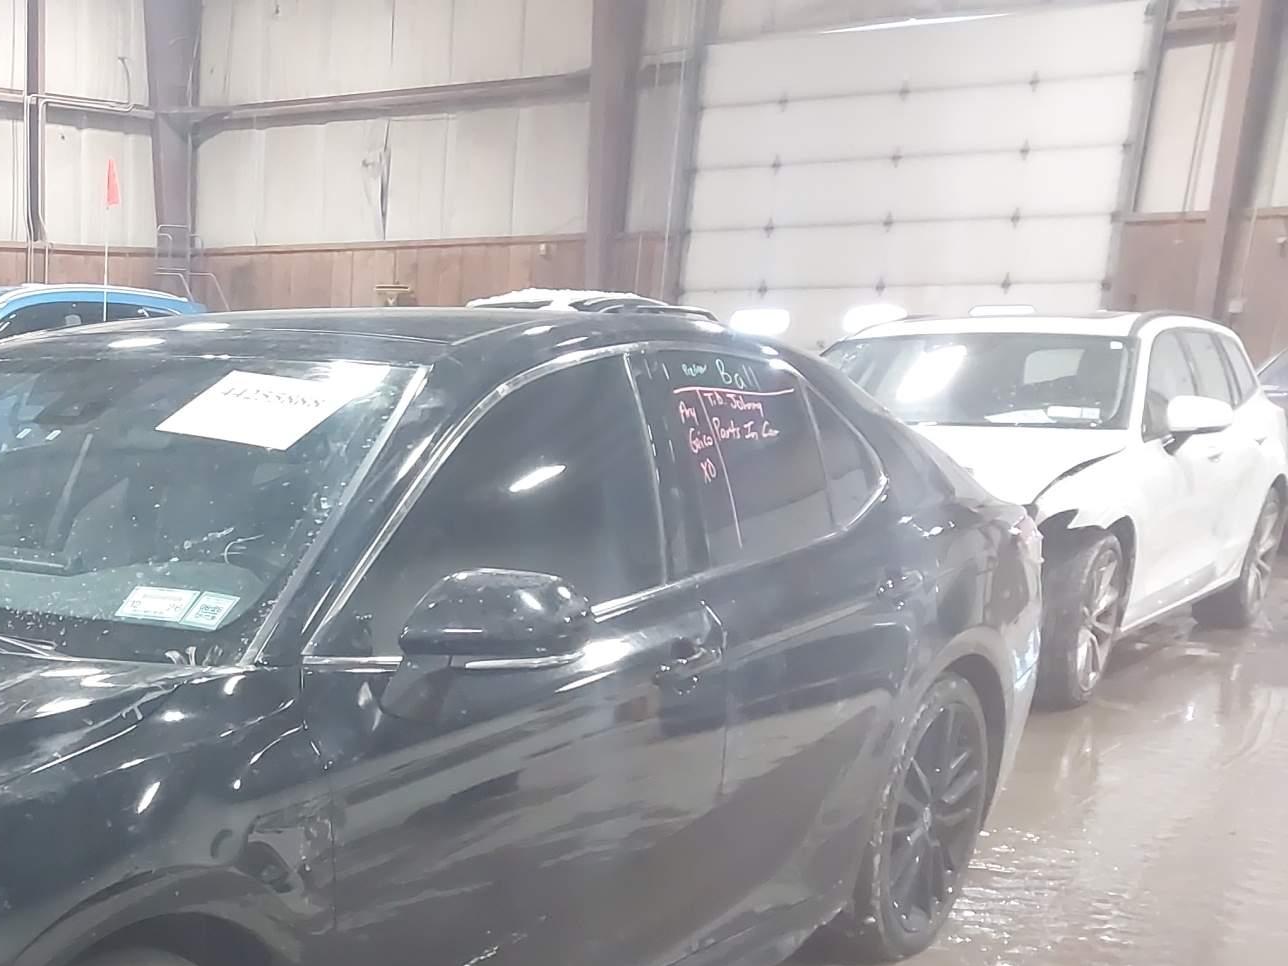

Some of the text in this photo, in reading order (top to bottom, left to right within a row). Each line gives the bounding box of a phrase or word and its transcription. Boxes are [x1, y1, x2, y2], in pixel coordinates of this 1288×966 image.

[715, 359, 761, 391] Ball
[712, 417, 741, 441] Parts
[744, 421, 759, 440] In
